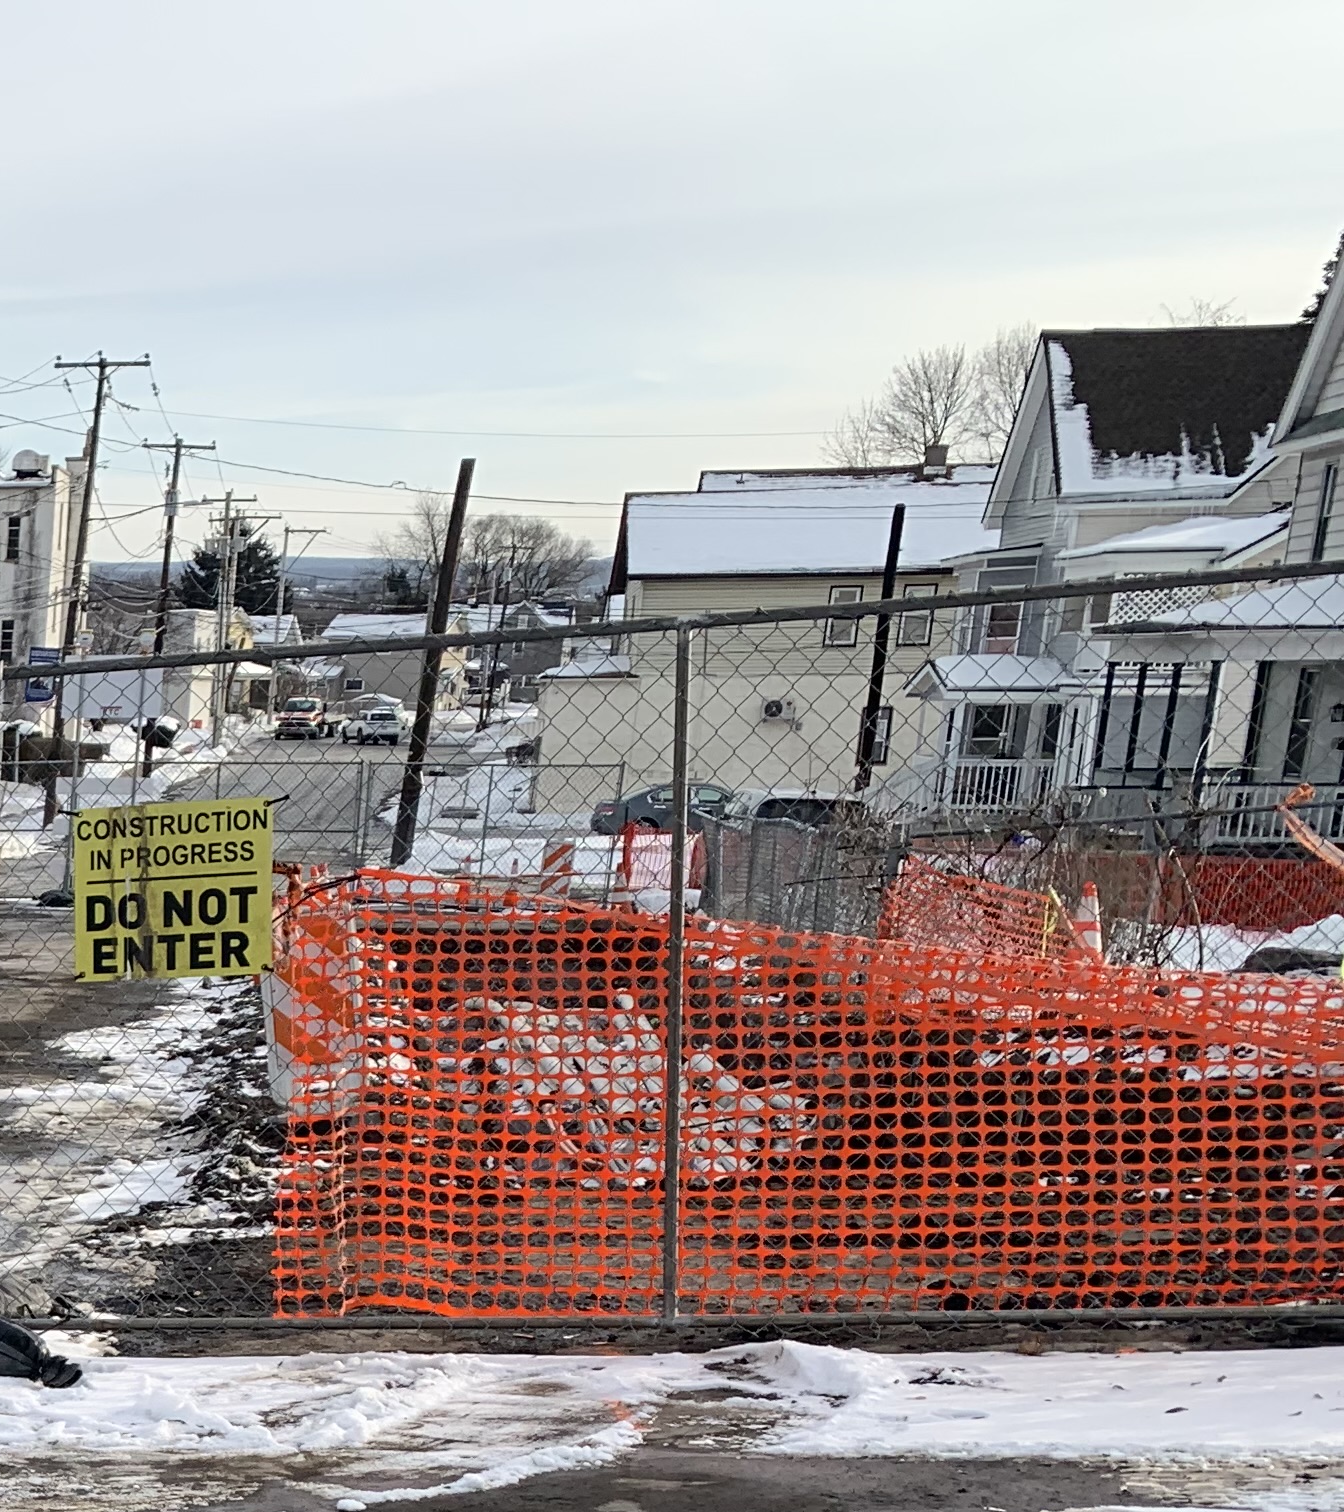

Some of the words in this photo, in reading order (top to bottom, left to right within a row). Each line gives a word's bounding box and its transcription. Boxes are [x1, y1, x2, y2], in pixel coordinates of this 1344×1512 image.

[77, 808, 268, 841] CONSTRUCTION
[90, 849, 111, 870] IN
[121, 840, 254, 868] PROGRESS
[86, 893, 146, 932] DO
[163, 886, 258, 928] NOT
[93, 931, 250, 974] ENTER
